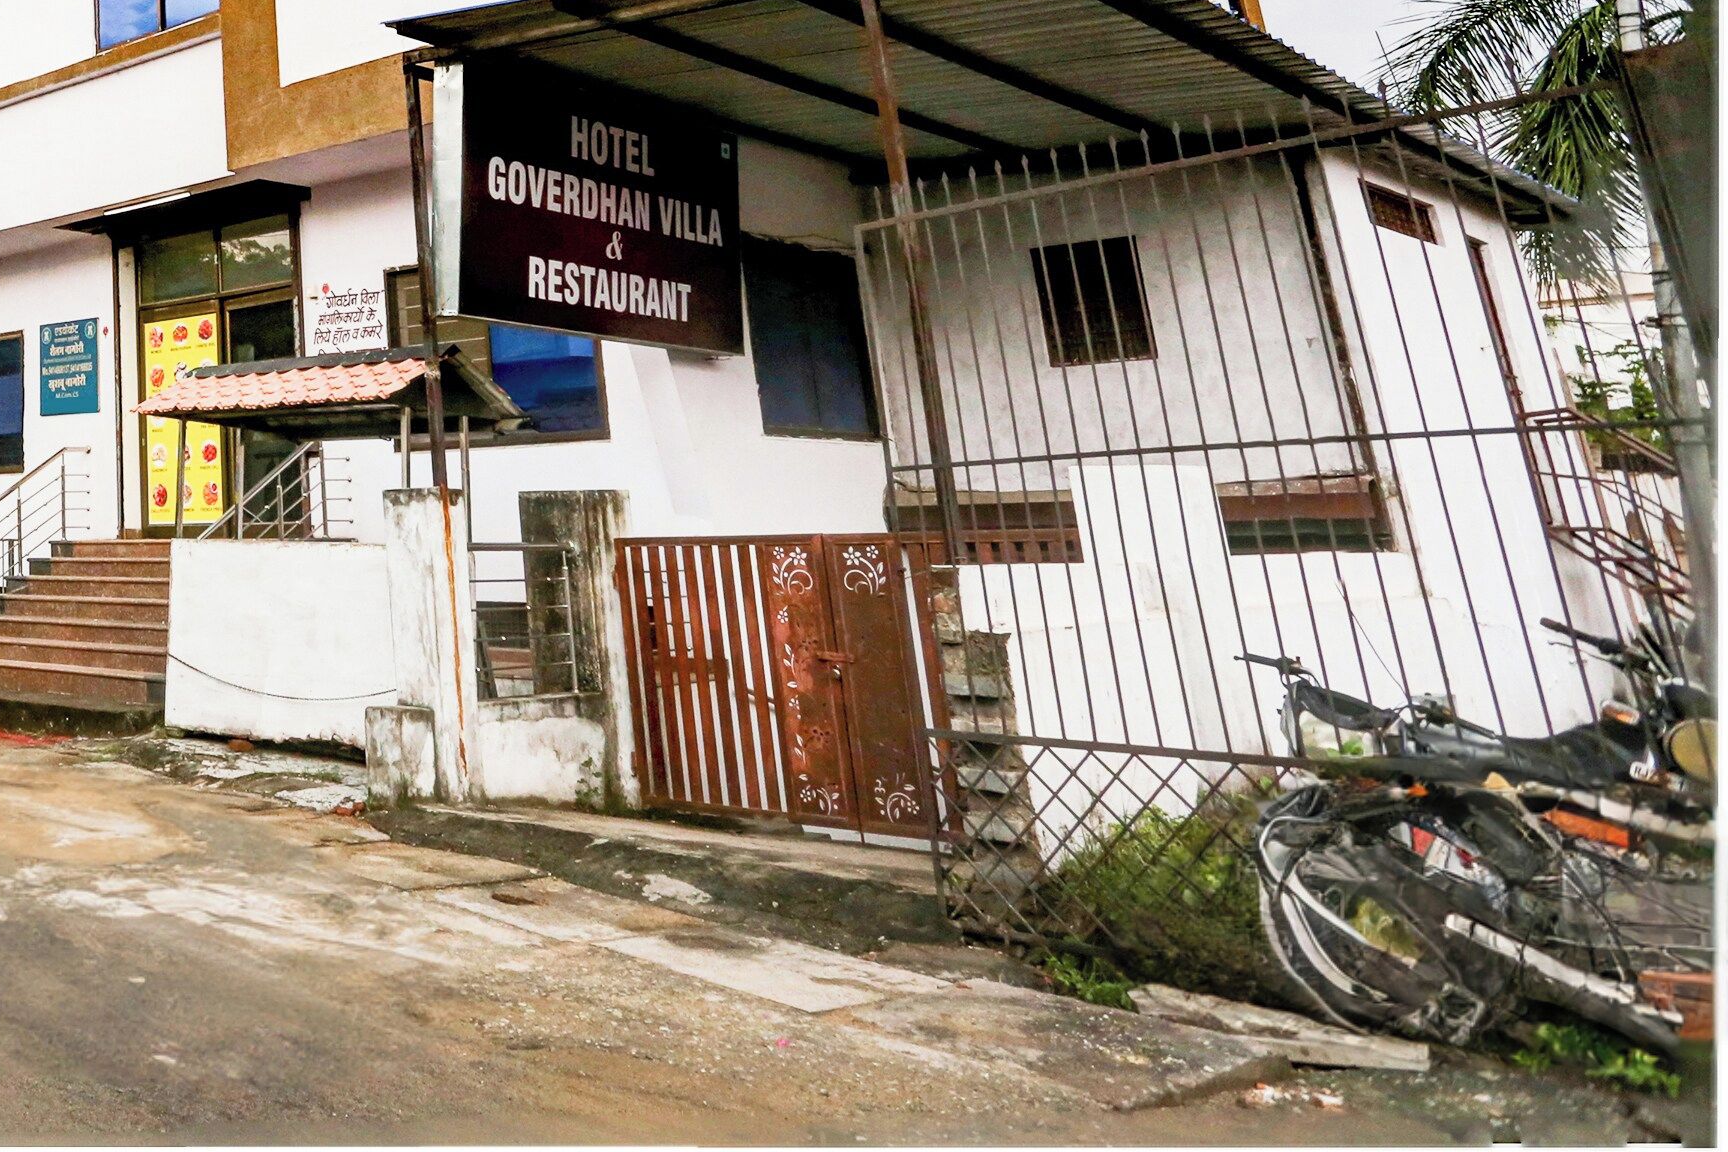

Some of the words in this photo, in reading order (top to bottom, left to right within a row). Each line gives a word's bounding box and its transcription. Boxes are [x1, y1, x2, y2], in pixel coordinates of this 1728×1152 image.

[571, 115, 655, 176] HOTEL
[488, 156, 651, 231] GOVERDHAN
[657, 195, 723, 247] VILLA
[605, 231, 623, 261] &
[326, 288, 358, 308] गोवर्धन
[361, 288, 380, 305] विला
[528, 255, 692, 323] RESTAURANT
[366, 307, 377, 321] के
[313, 327, 331, 345] लिये
[352, 329, 359, 341] व
[361, 320, 383, 339] कमरे
